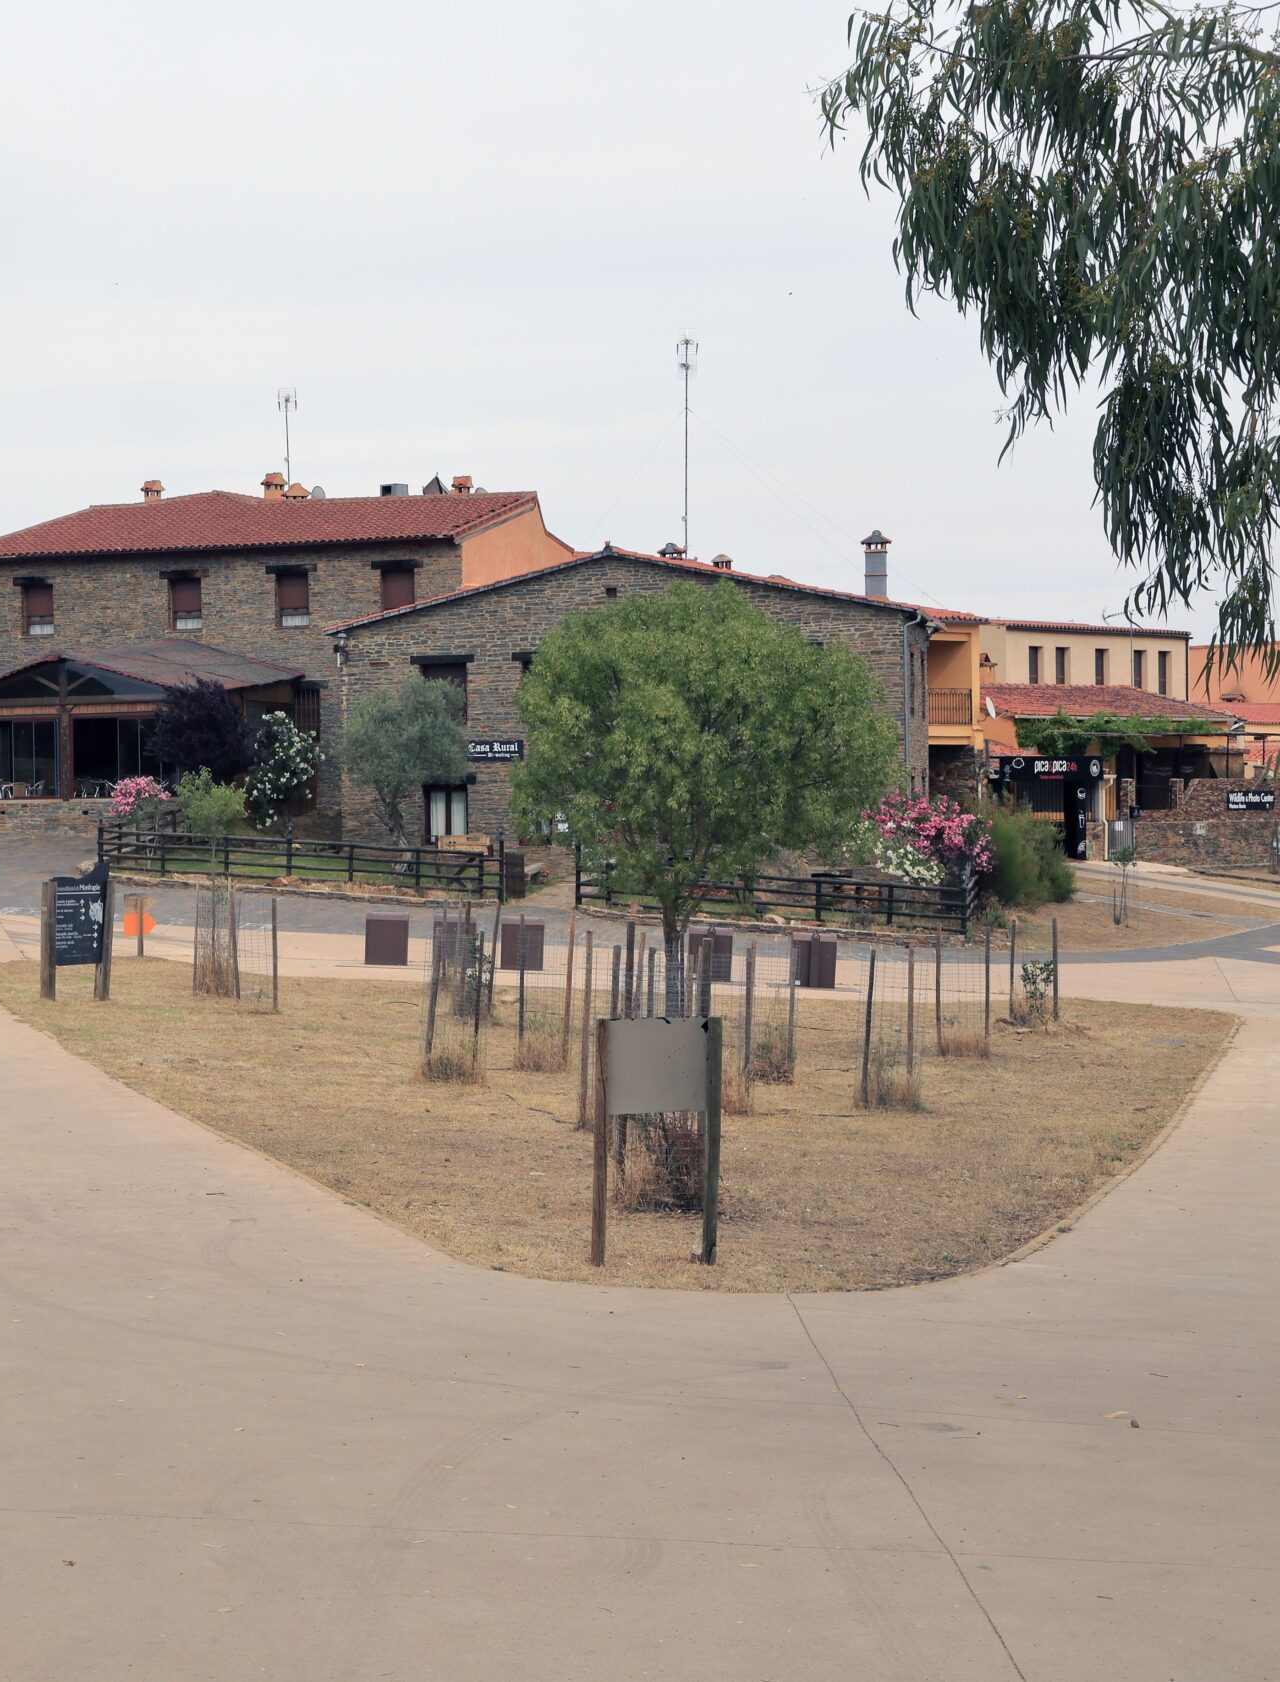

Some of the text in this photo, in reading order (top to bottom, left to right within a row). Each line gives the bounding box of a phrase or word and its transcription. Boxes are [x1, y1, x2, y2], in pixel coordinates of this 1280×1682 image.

[468, 742, 518, 752] Casa Rural
[1229, 792, 1245, 802] Wildlife
[1248, 792, 1260, 802] Photo
[1260, 792, 1274, 802] Center
